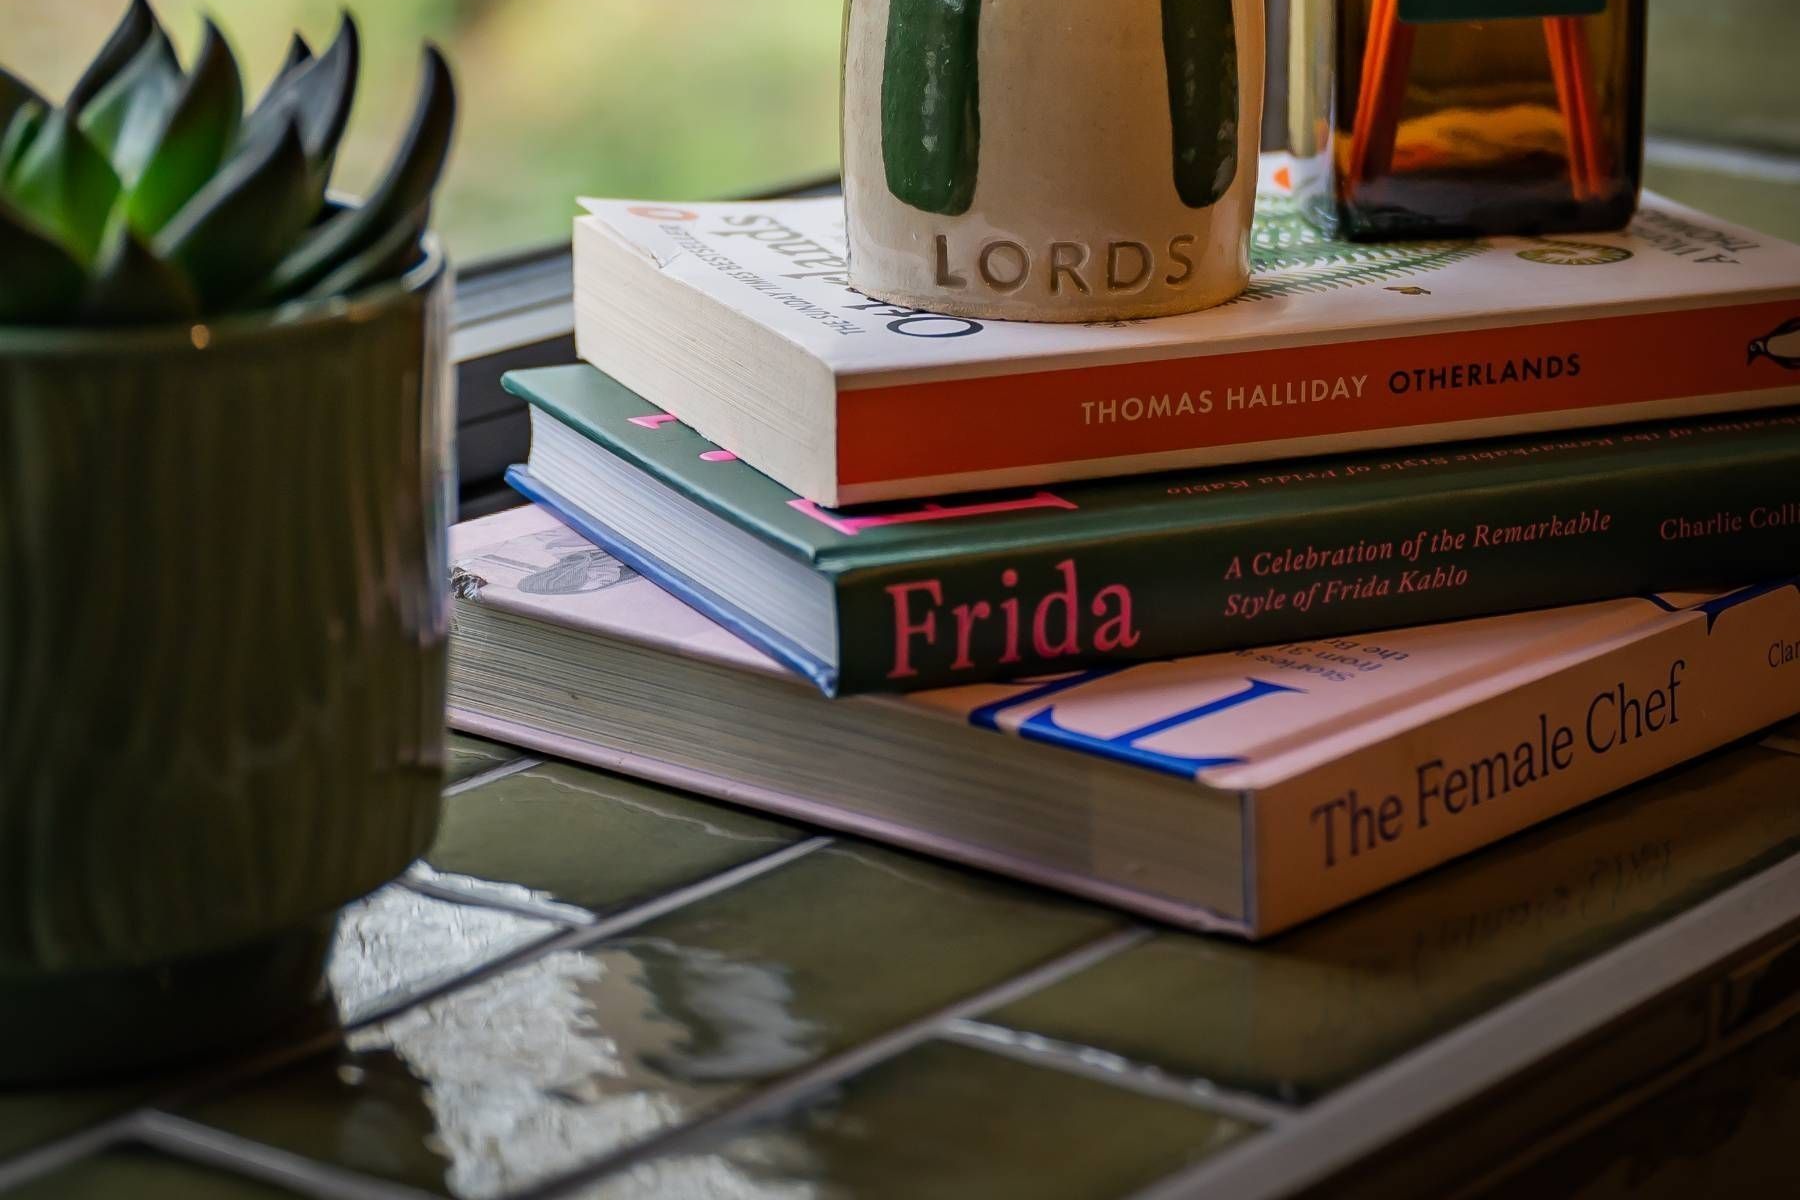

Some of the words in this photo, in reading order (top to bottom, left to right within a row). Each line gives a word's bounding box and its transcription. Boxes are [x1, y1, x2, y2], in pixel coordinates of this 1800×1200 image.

[936, 234, 1195, 295] LORDS
[726, 271, 782, 291] TIMES
[765, 289, 839, 320] SUNDAY
[820, 319, 867, 335] THE
[1081, 390, 1213, 425] THOMAS
[1227, 375, 1368, 411] HALLIDAY
[1389, 353, 1581, 395] OTHERLANDS
[1701, 416, 1800, 432] bration
[1345, 464, 1370, 477] of
[1378, 457, 1448, 469] Style
[1258, 470, 1337, 484] Frida
[1660, 512, 1742, 540] Charlie
[1224, 556, 1242, 580] A
[1252, 540, 1393, 576] Celebration
[1400, 532, 1427, 562] of
[1430, 529, 1465, 554] the
[1472, 509, 1612, 547] Remarkable
[1224, 590, 1286, 619] Style
[1292, 583, 1320, 612] of
[1322, 576, 1389, 604] Frida
[1397, 564, 1468, 593] Kahlo
[885, 559, 1140, 678] Frida
[1315, 651, 1383, 671] from
[1363, 646, 1409, 661] the
[1256, 654, 1355, 681] Stories
[1310, 789, 1403, 869] The
[1415, 714, 1573, 828] Female
[1586, 659, 1686, 753] Chef
